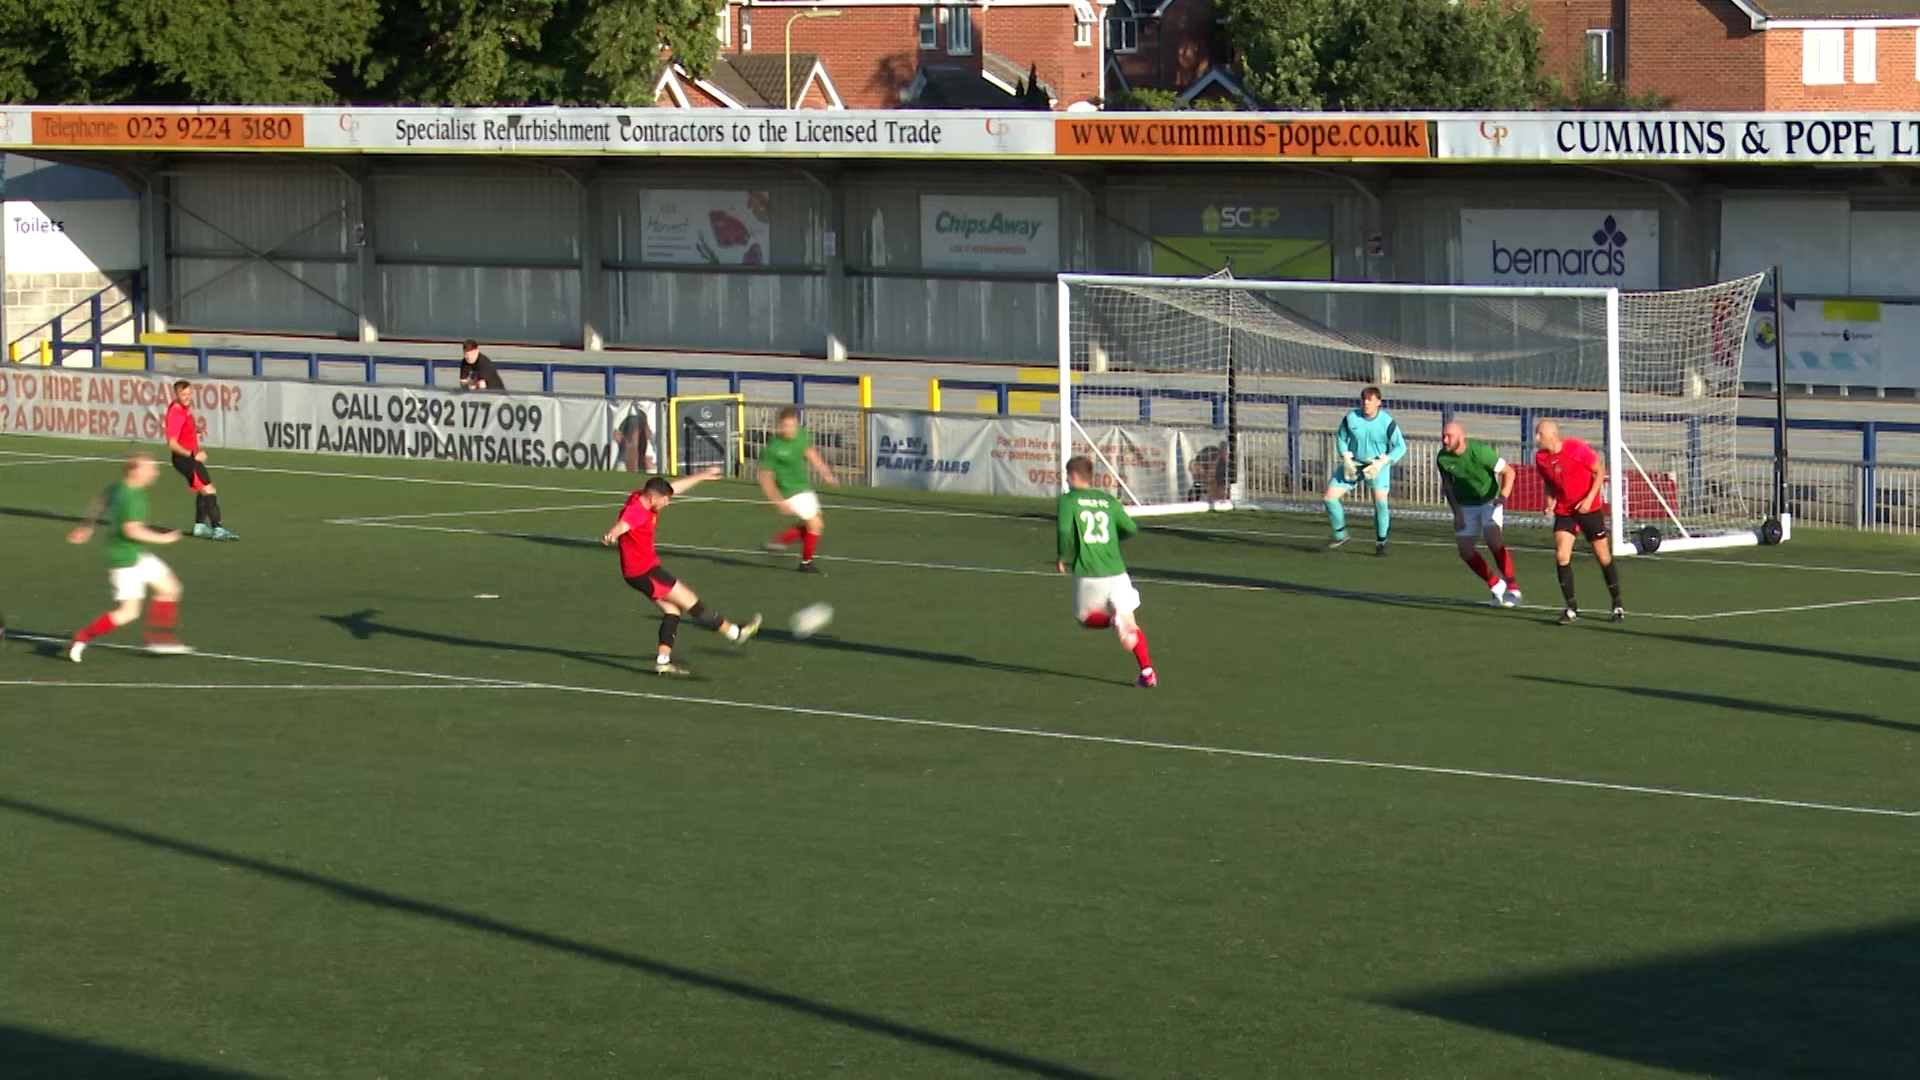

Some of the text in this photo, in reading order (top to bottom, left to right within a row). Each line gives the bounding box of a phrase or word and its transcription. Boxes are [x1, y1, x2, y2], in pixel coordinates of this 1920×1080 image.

[42, 116, 292, 141] Telephone: 023 9224 3180
[395, 118, 941, 145] Specialist Refurbishment Contractors to the Licensed Trade
[1071, 120, 1421, 154] www.cummins-pope.co.uk
[1556, 120, 1726, 154] CUMMINS
[1741, 121, 1771, 155] &
[1785, 121, 1875, 155] POPE
[12, 217, 65, 233] Toilets
[935, 210, 1042, 241] ChipsAway
[1492, 239, 1626, 277] bernards
[12, 373, 37, 399] TO
[42, 375, 82, 402] HIRE
[87, 377, 114, 406] AN
[119, 378, 242, 412] EXCATOR?
[15, 405, 28, 431] A
[32, 406, 120, 436] DUMPER?
[124, 411, 138, 438] A
[332, 391, 542, 432] CALL 02392 177 099
[264, 420, 611, 472] VISIT AJANDMJPLANTSALES.COM
[876, 457, 971, 474] PLANT SALES
[1080, 510, 1110, 544] 23
